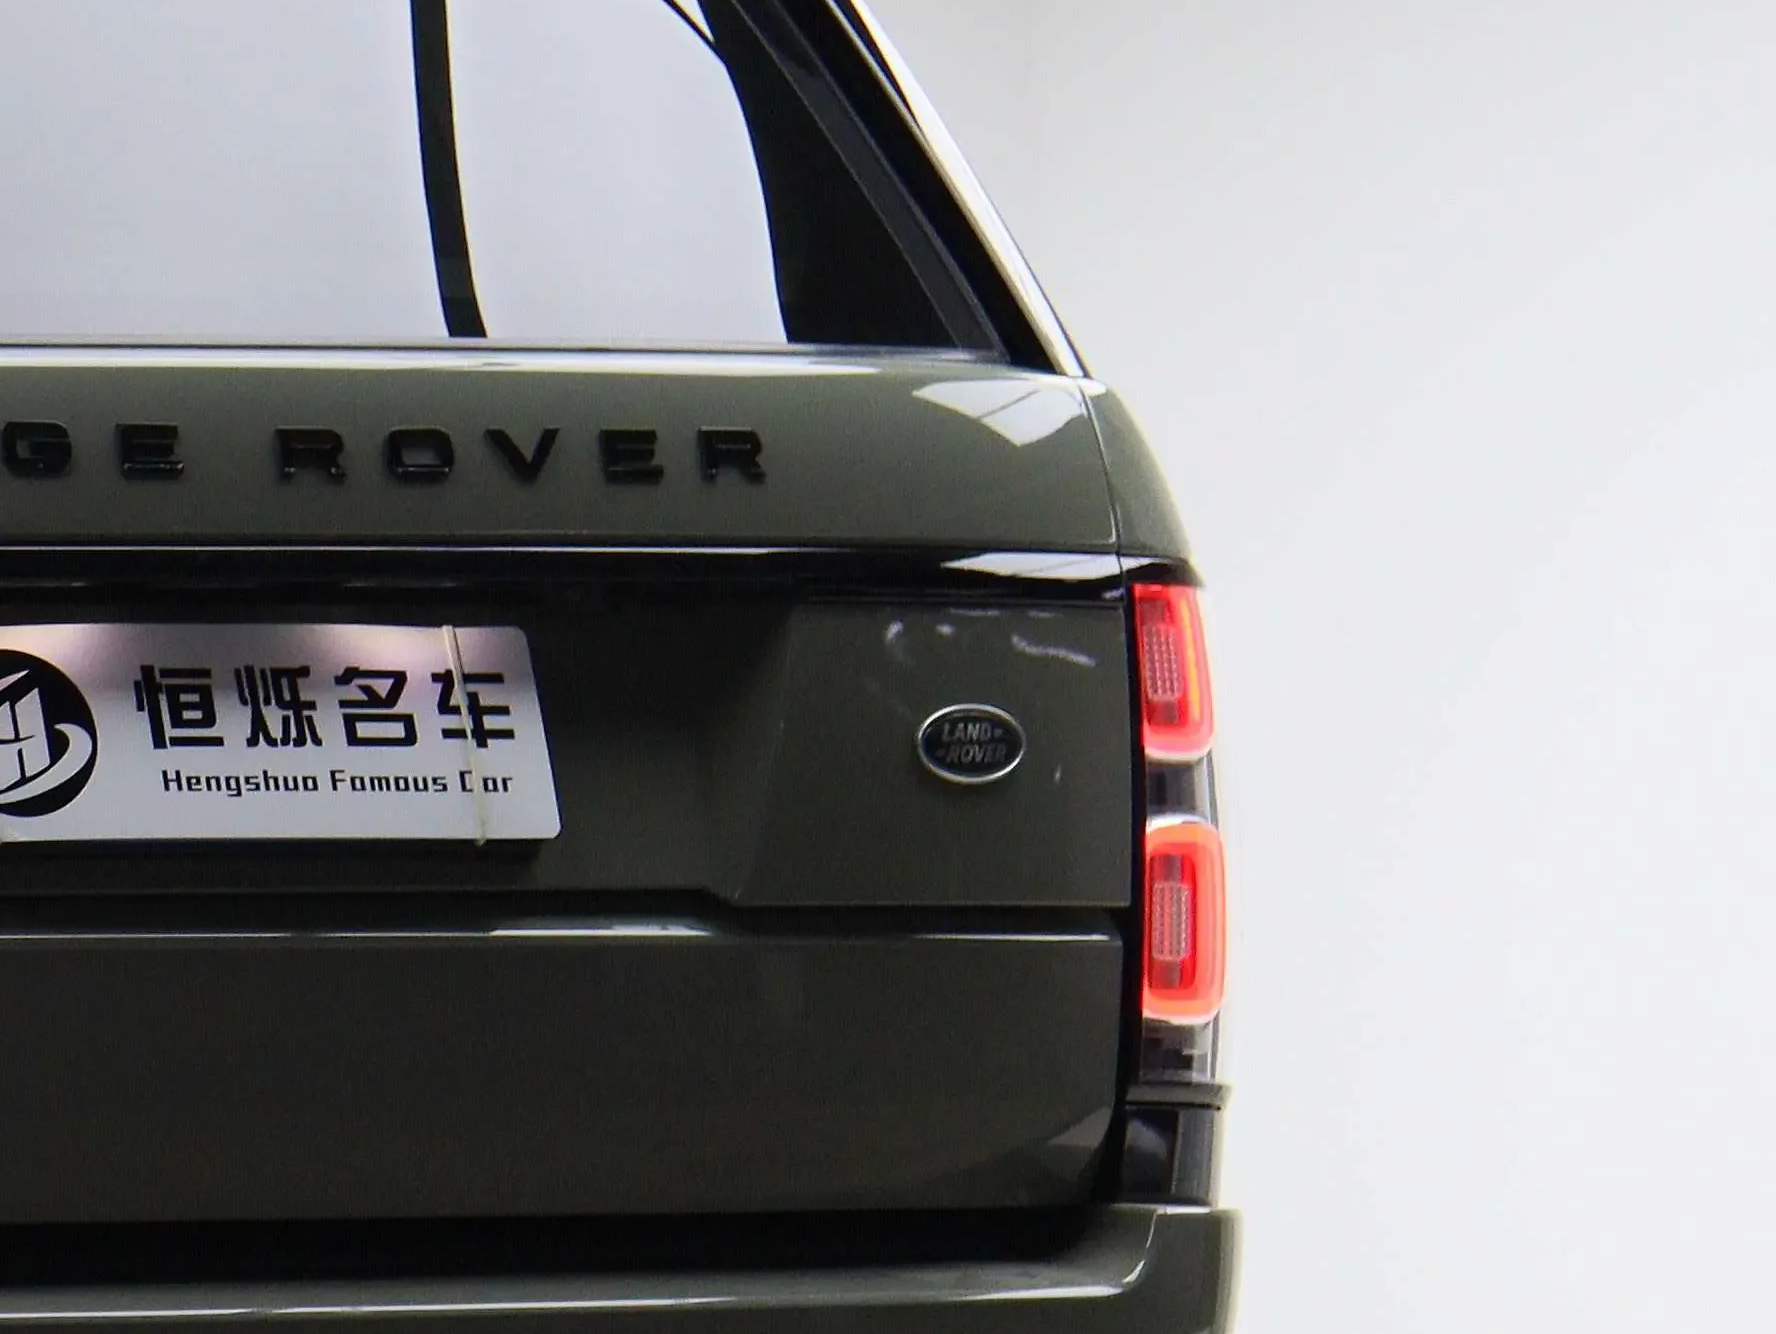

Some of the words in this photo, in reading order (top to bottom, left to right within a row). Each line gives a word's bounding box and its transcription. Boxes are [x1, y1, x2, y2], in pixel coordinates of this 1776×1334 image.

[274, 425, 767, 484] ROVER
[133, 664, 515, 750] 恒烁名车
[942, 722, 990, 742] LAND
[947, 744, 1006, 764] ROVER
[161, 769, 319, 797] Hengshuo
[330, 769, 448, 794] Famous
[458, 769, 514, 793] Car
